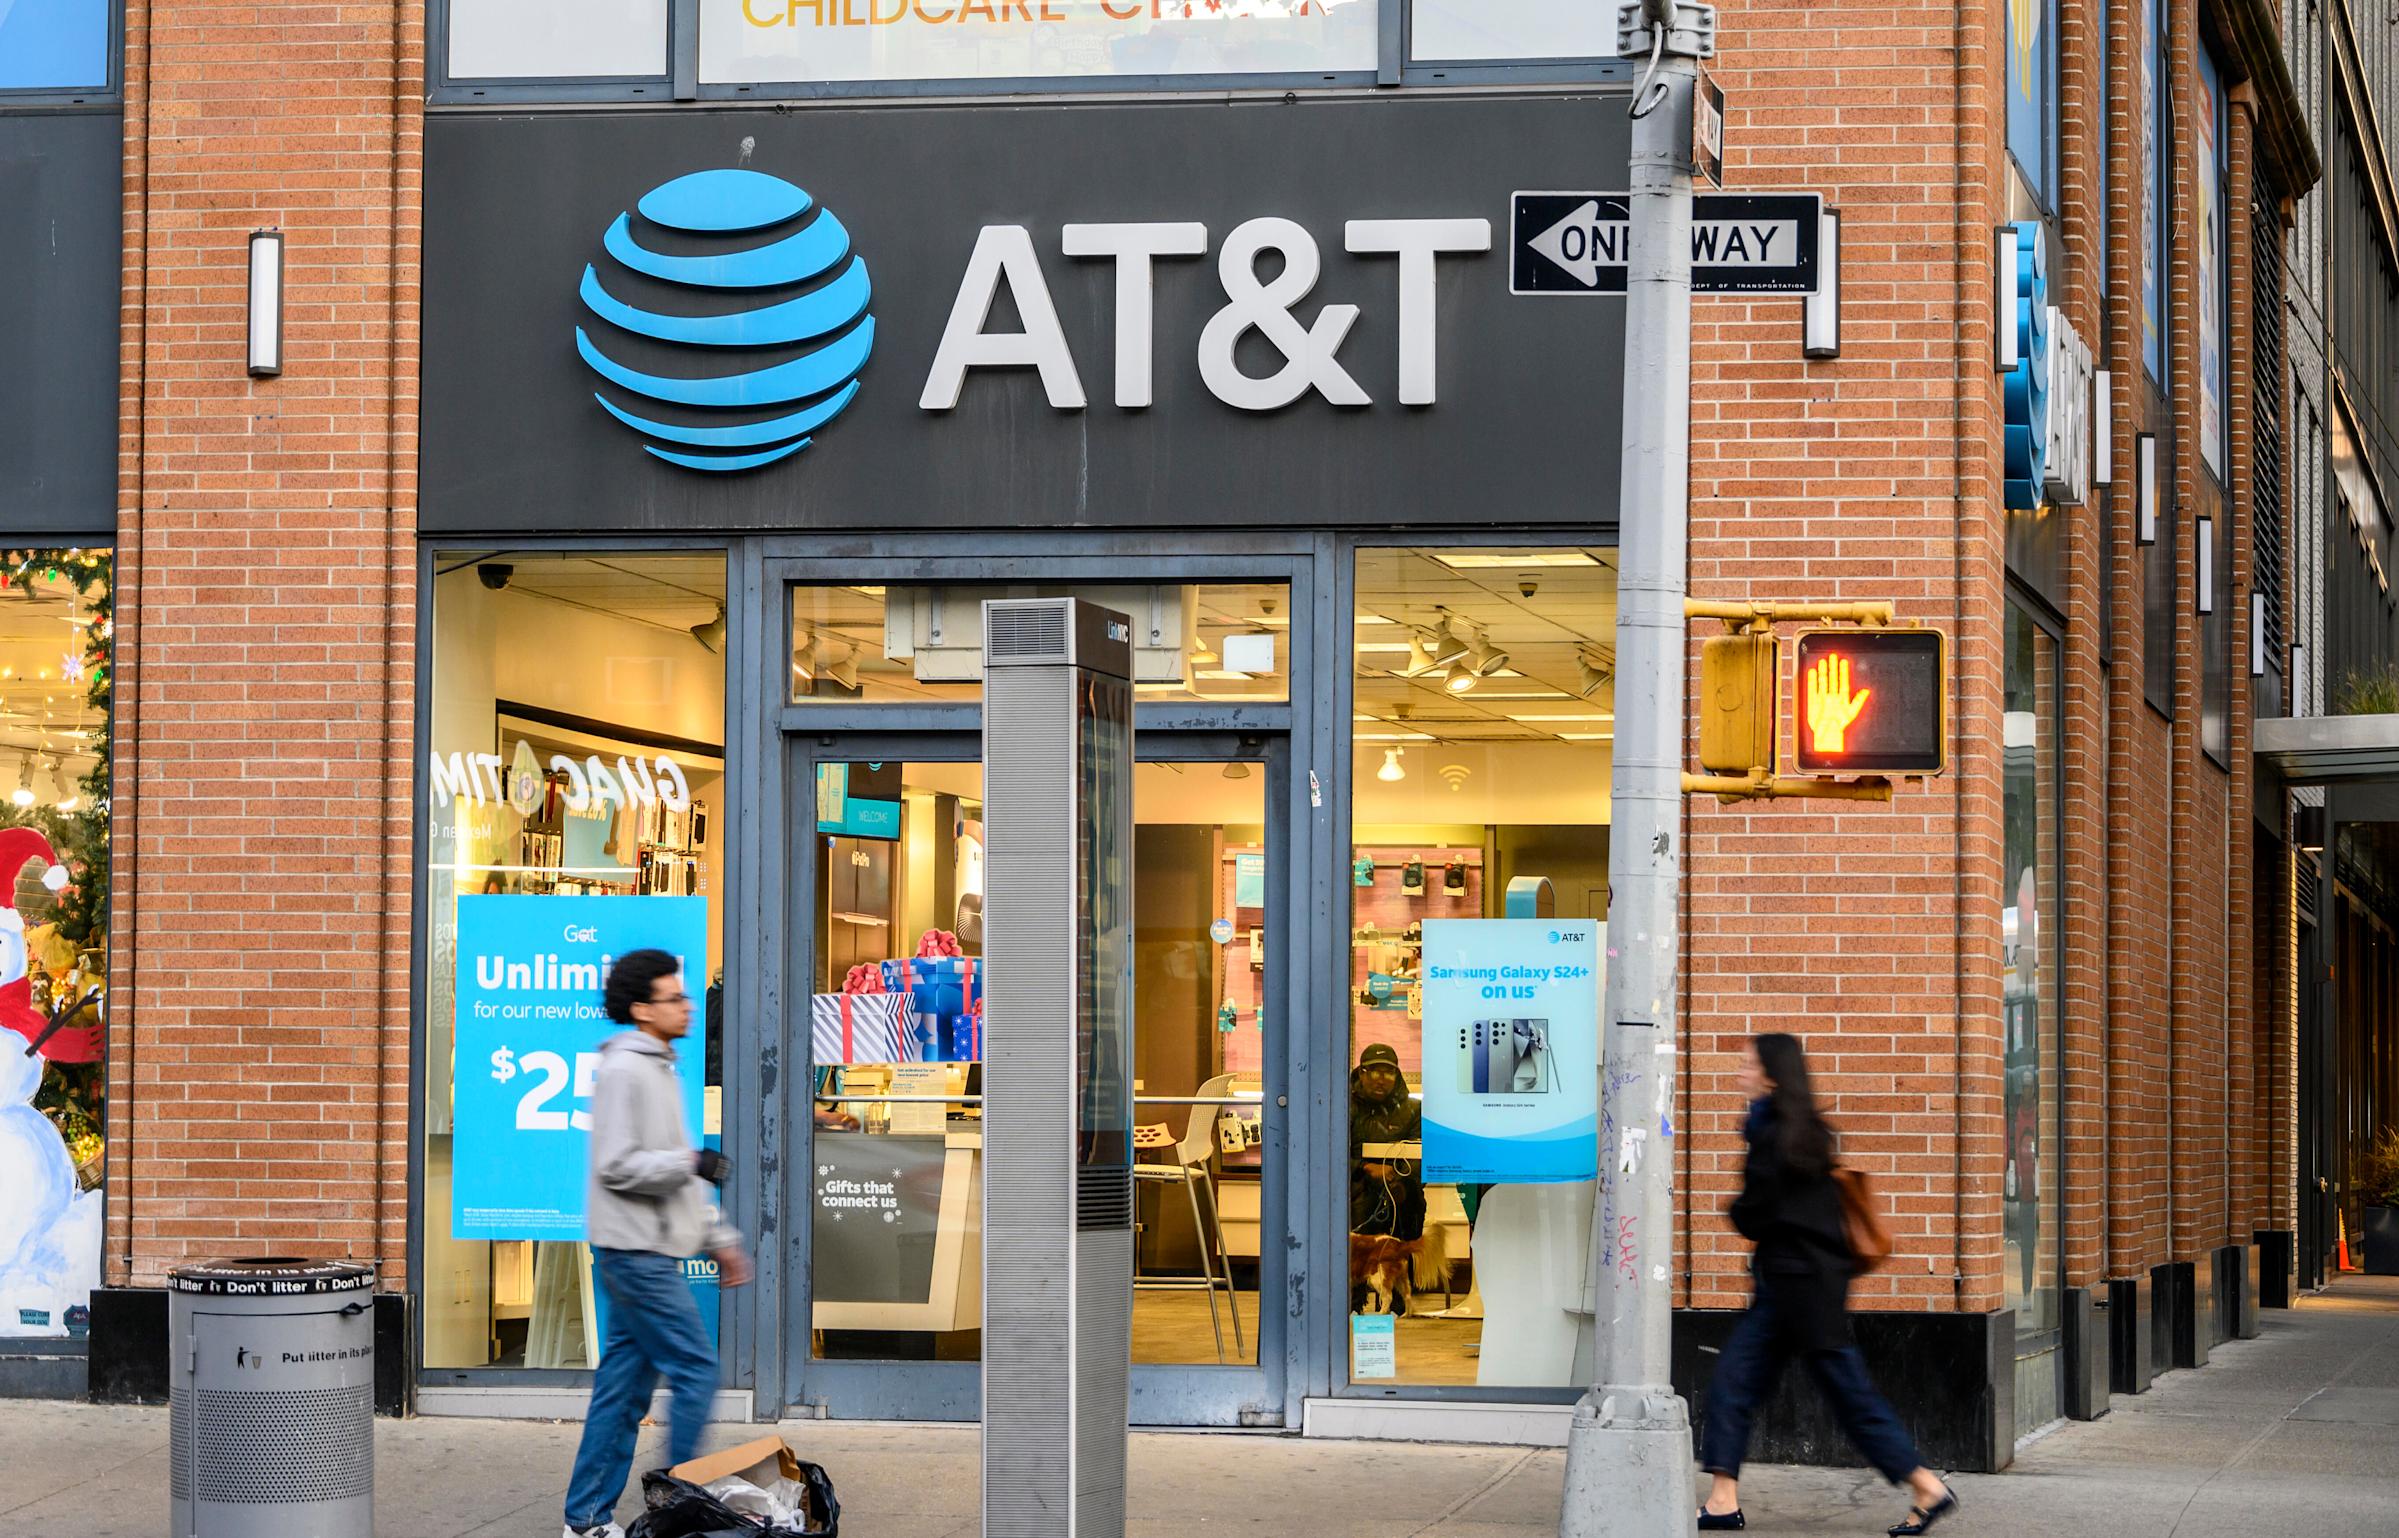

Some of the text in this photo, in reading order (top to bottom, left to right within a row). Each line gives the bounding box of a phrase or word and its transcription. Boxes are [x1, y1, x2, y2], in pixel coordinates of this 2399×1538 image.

[1691, 225, 1779, 262] WAY
[919, 216, 1491, 411] AT&T
[1108, 619, 1129, 643] LinkNYC
[858, 810, 888, 824] WELCOME
[564, 924, 598, 943] Get
[1561, 933, 1585, 942] AT&T
[1501, 966, 1550, 981] Galaxy
[1554, 966, 1589, 978] S24+
[1481, 985, 1507, 999] on
[474, 1000, 499, 1018] for
[502, 1004, 532, 1018] our
[535, 1004, 572, 1018] new
[825, 1180, 894, 1194] Gifts that
[822, 1196, 897, 1208] connect us
[179, 1278, 204, 1292] litter
[226, 1281, 266, 1294] Don't
[272, 1281, 307, 1293] litter
[332, 1277, 360, 1290] Don't
[282, 1352, 304, 1363] Put
[338, 1350, 348, 1360] in
[349, 1347, 360, 1358] its
